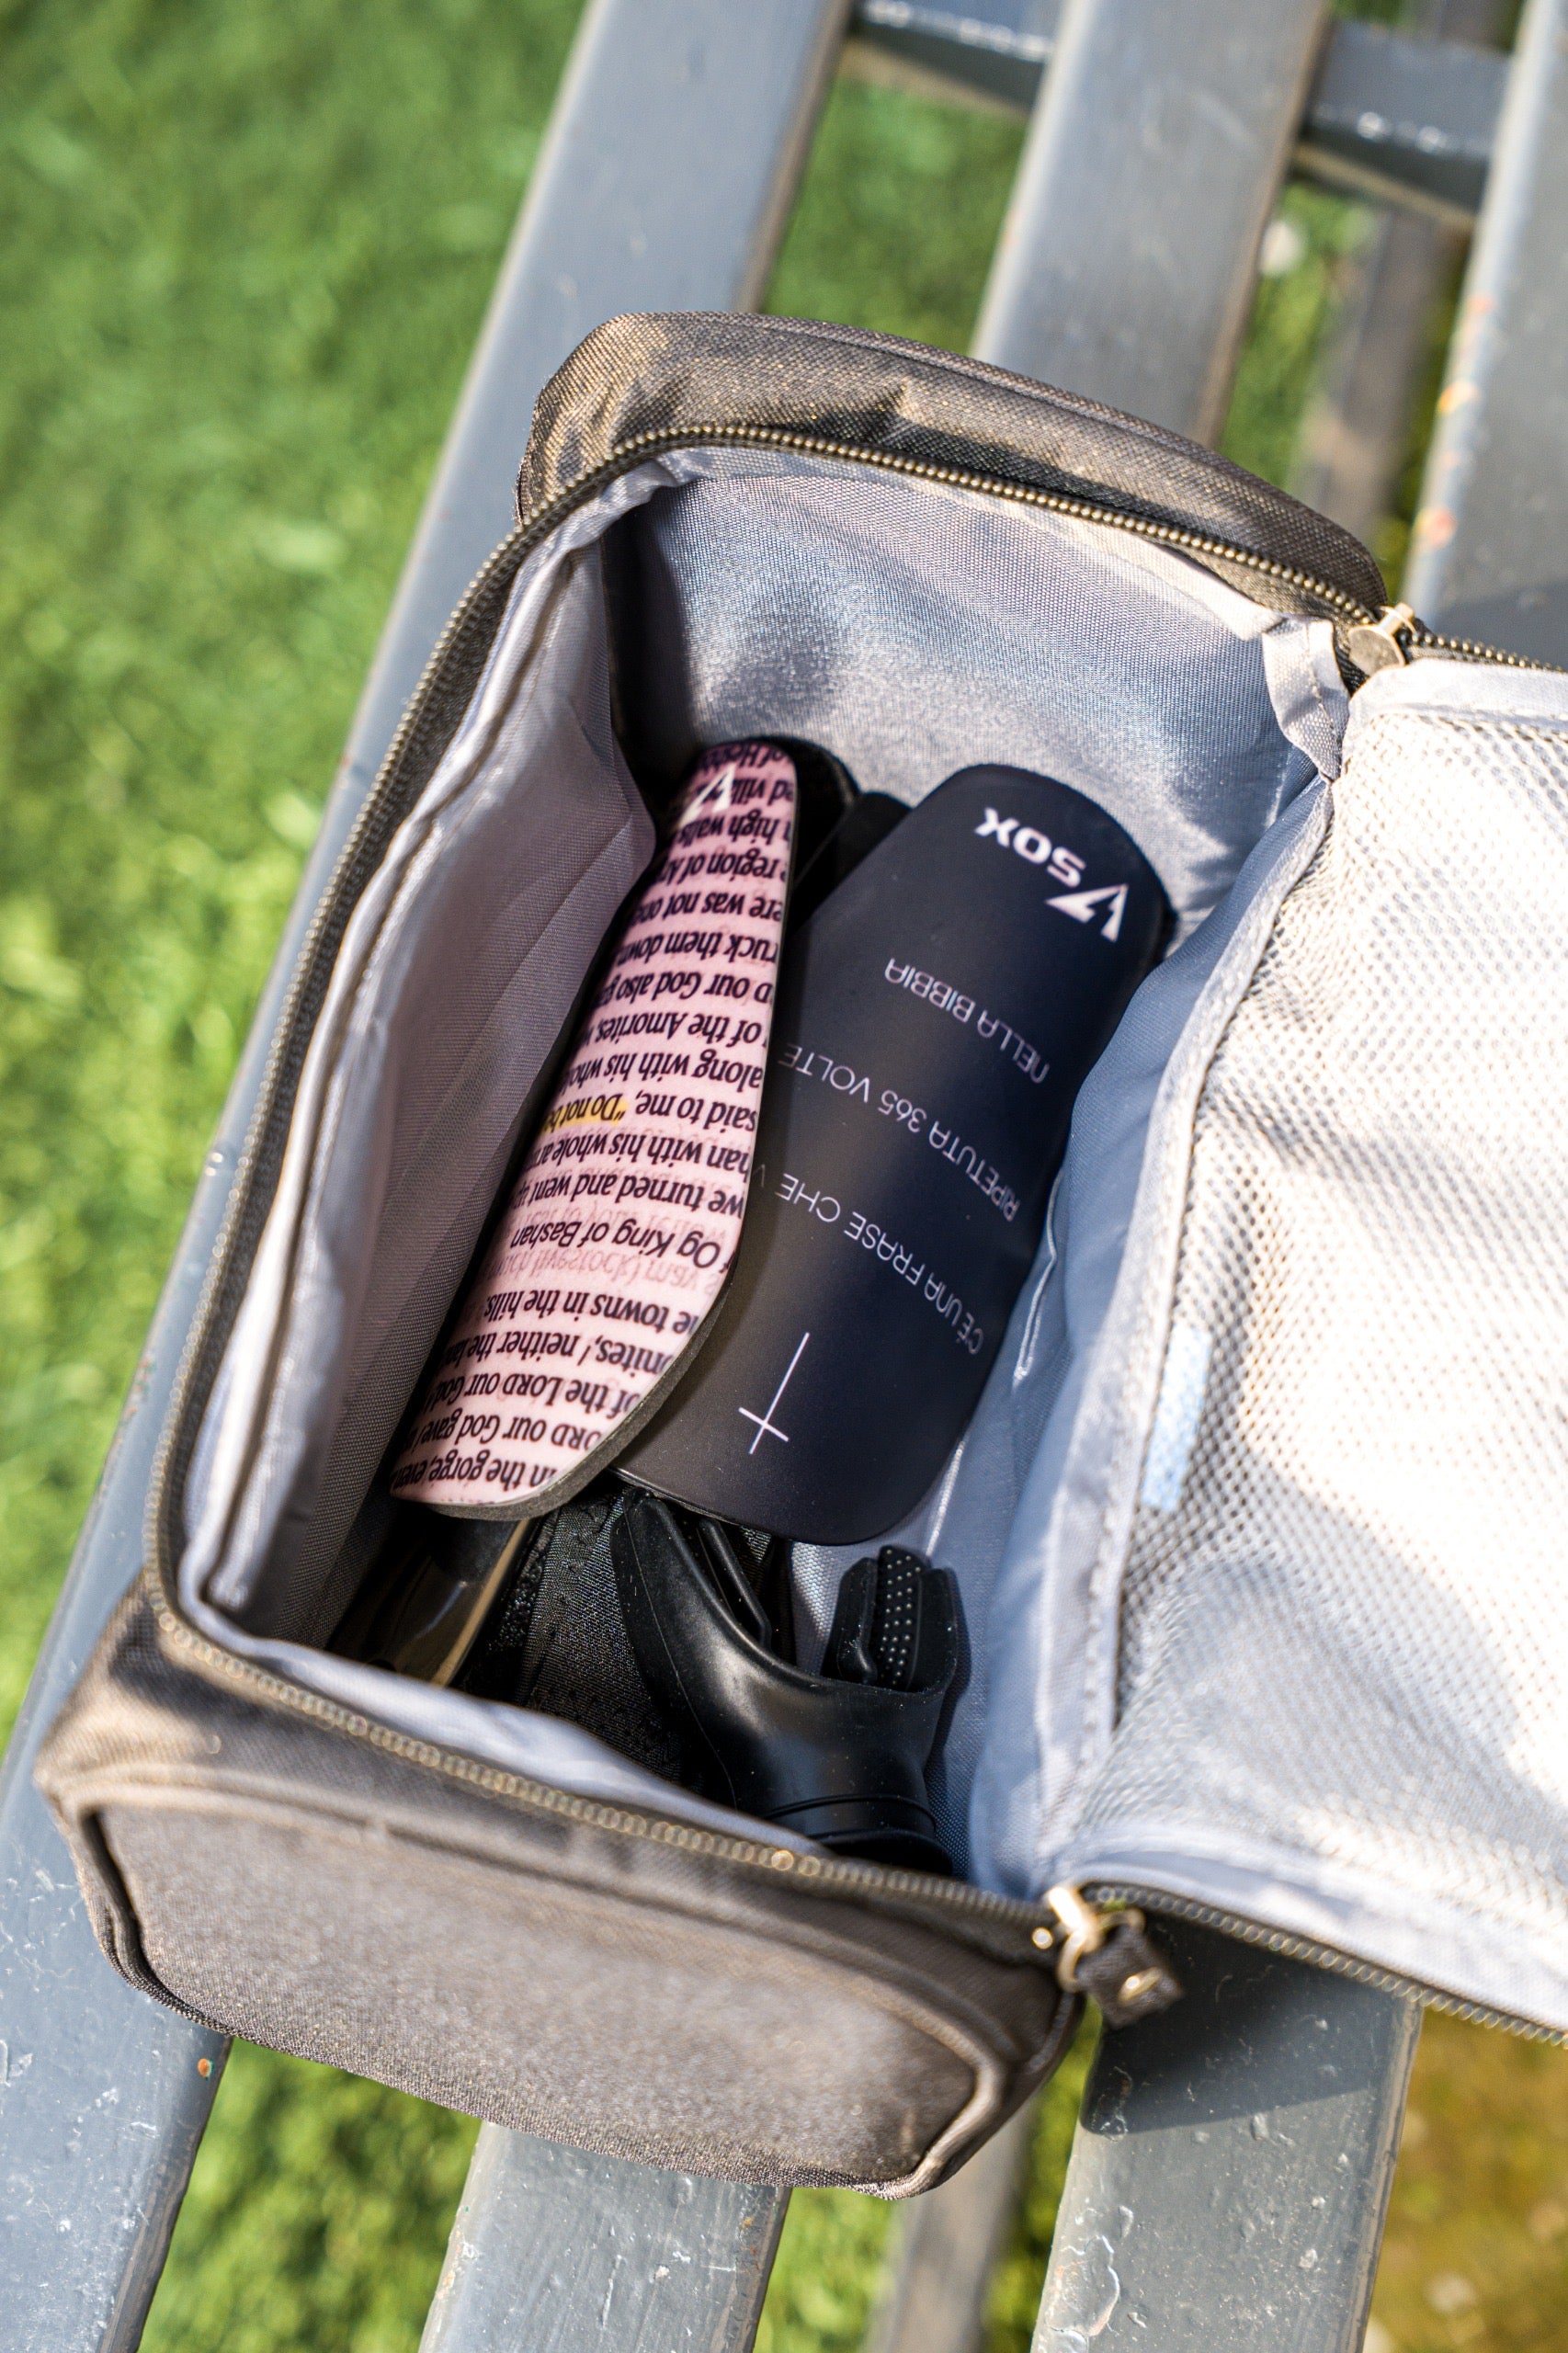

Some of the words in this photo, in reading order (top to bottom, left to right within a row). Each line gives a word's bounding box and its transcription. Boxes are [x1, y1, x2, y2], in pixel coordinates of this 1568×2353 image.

[728, 809, 780, 846] high
[974, 807, 1086, 889] SOX
[676, 855, 706, 885] of
[706, 847, 780, 882] region
[661, 892, 701, 920] not
[701, 892, 745, 915] was
[664, 931, 722, 961] them
[723, 935, 778, 965] ruck
[615, 974, 654, 1004] also
[652, 972, 701, 1001] God
[704, 974, 750, 1000] our
[884, 958, 976, 1023] BIBBIA
[688, 1014, 731, 1044] the
[725, 1020, 762, 1048] of
[977, 1010, 1050, 1084] NELLA
[604, 1053, 638, 1083] his
[638, 1052, 691, 1082] with
[691, 1050, 763, 1093] along
[778, 1043, 869, 1103] VOLTE
[558, 1097, 594, 1128] not
[635, 1090, 676, 1116] me,
[677, 1097, 704, 1124] to
[704, 1100, 757, 1133] said
[878, 1090, 927, 1132] 365
[553, 1134, 607, 1165] whole
[608, 1132, 646, 1164] his
[646, 1135, 703, 1167] with
[928, 1120, 1019, 1222] RIPETUTA
[528, 1176, 573, 1205] went
[570, 1174, 619, 1203] and
[615, 1175, 706, 1213] turned
[774, 1173, 841, 1222] CHE
[508, 1221, 582, 1249] Bashan
[577, 1223, 611, 1248] of
[611, 1218, 676, 1259] King
[677, 1230, 722, 1269] Og
[843, 1211, 926, 1286] FRASE
[483, 1290, 525, 1323] hills.
[523, 1290, 561, 1320] the
[562, 1291, 590, 1322] in
[590, 1294, 670, 1335] towns
[924, 1272, 962, 1326] UNA
[464, 1335, 497, 1363] the
[496, 1331, 580, 1361] neither
[462, 1373, 500, 1397] our
[565, 1379, 610, 1420] the
[454, 1414, 500, 1446] God
[502, 1415, 547, 1442] our
[428, 1449, 491, 1484] gorge,
[487, 1460, 526, 1492] the
